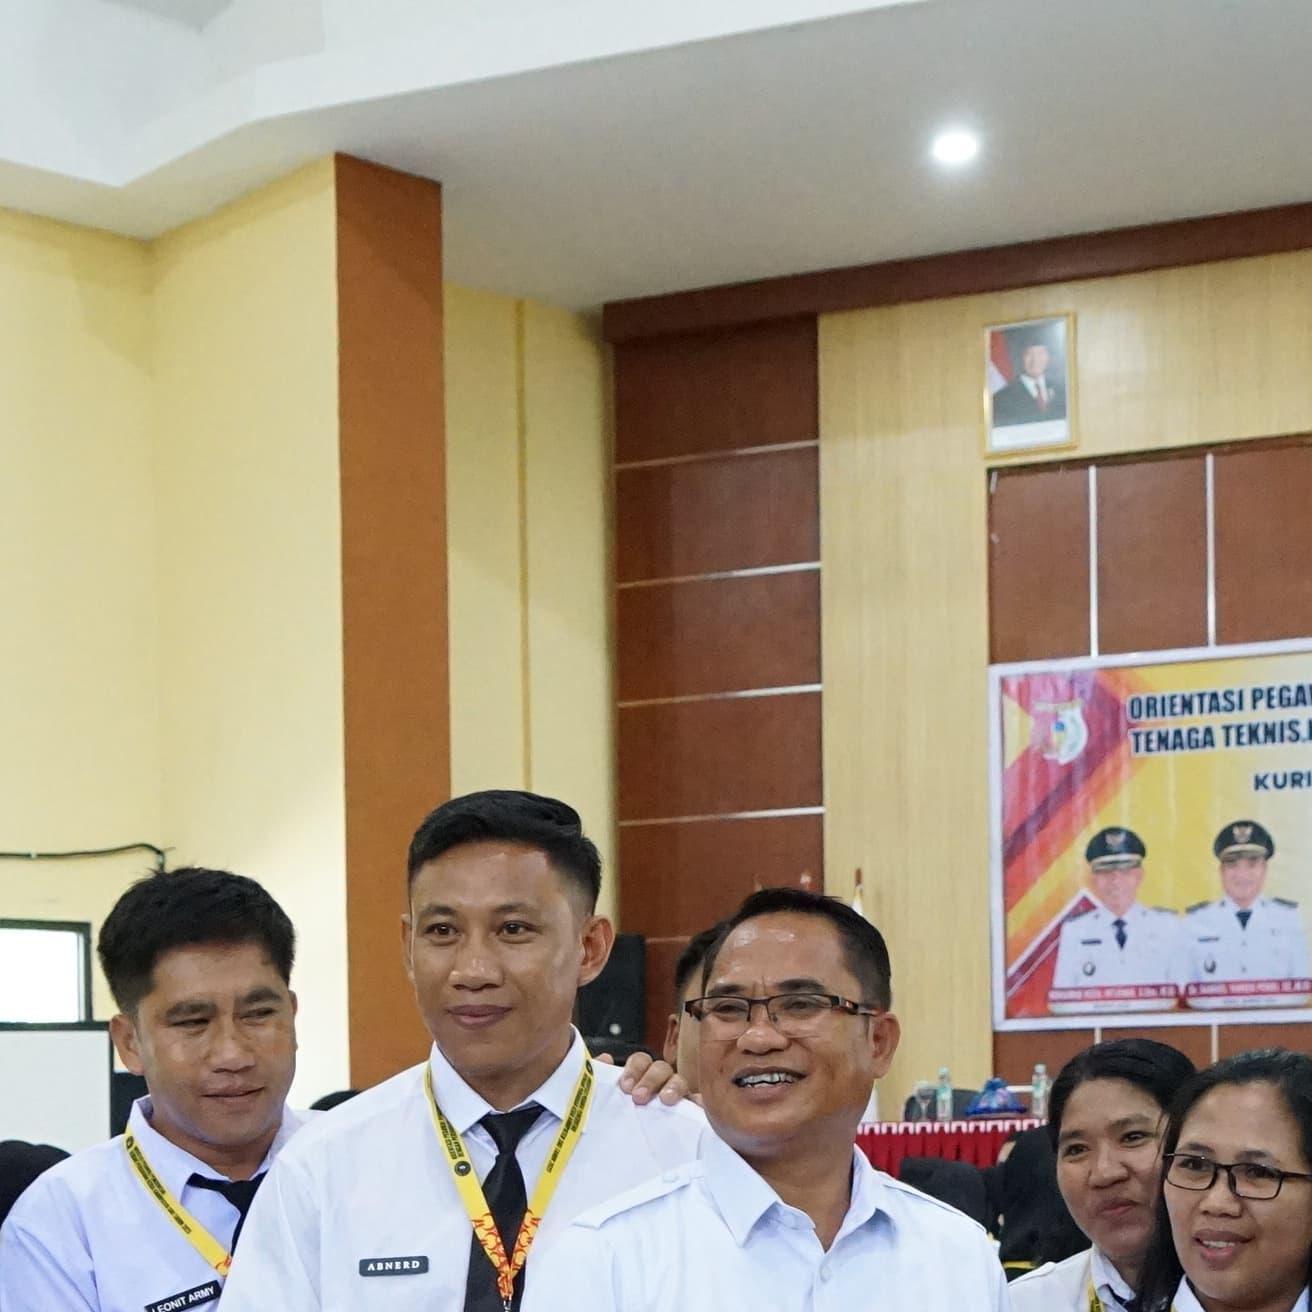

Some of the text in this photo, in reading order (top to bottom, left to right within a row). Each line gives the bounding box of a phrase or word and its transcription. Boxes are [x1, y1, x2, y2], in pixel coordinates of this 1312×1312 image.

[1130, 689, 1244, 721] ORIENTASI
[1132, 726, 1216, 754] TENAGA
[367, 1260, 420, 1271] ABNERD
[188, 1285, 215, 1304] ARMY
